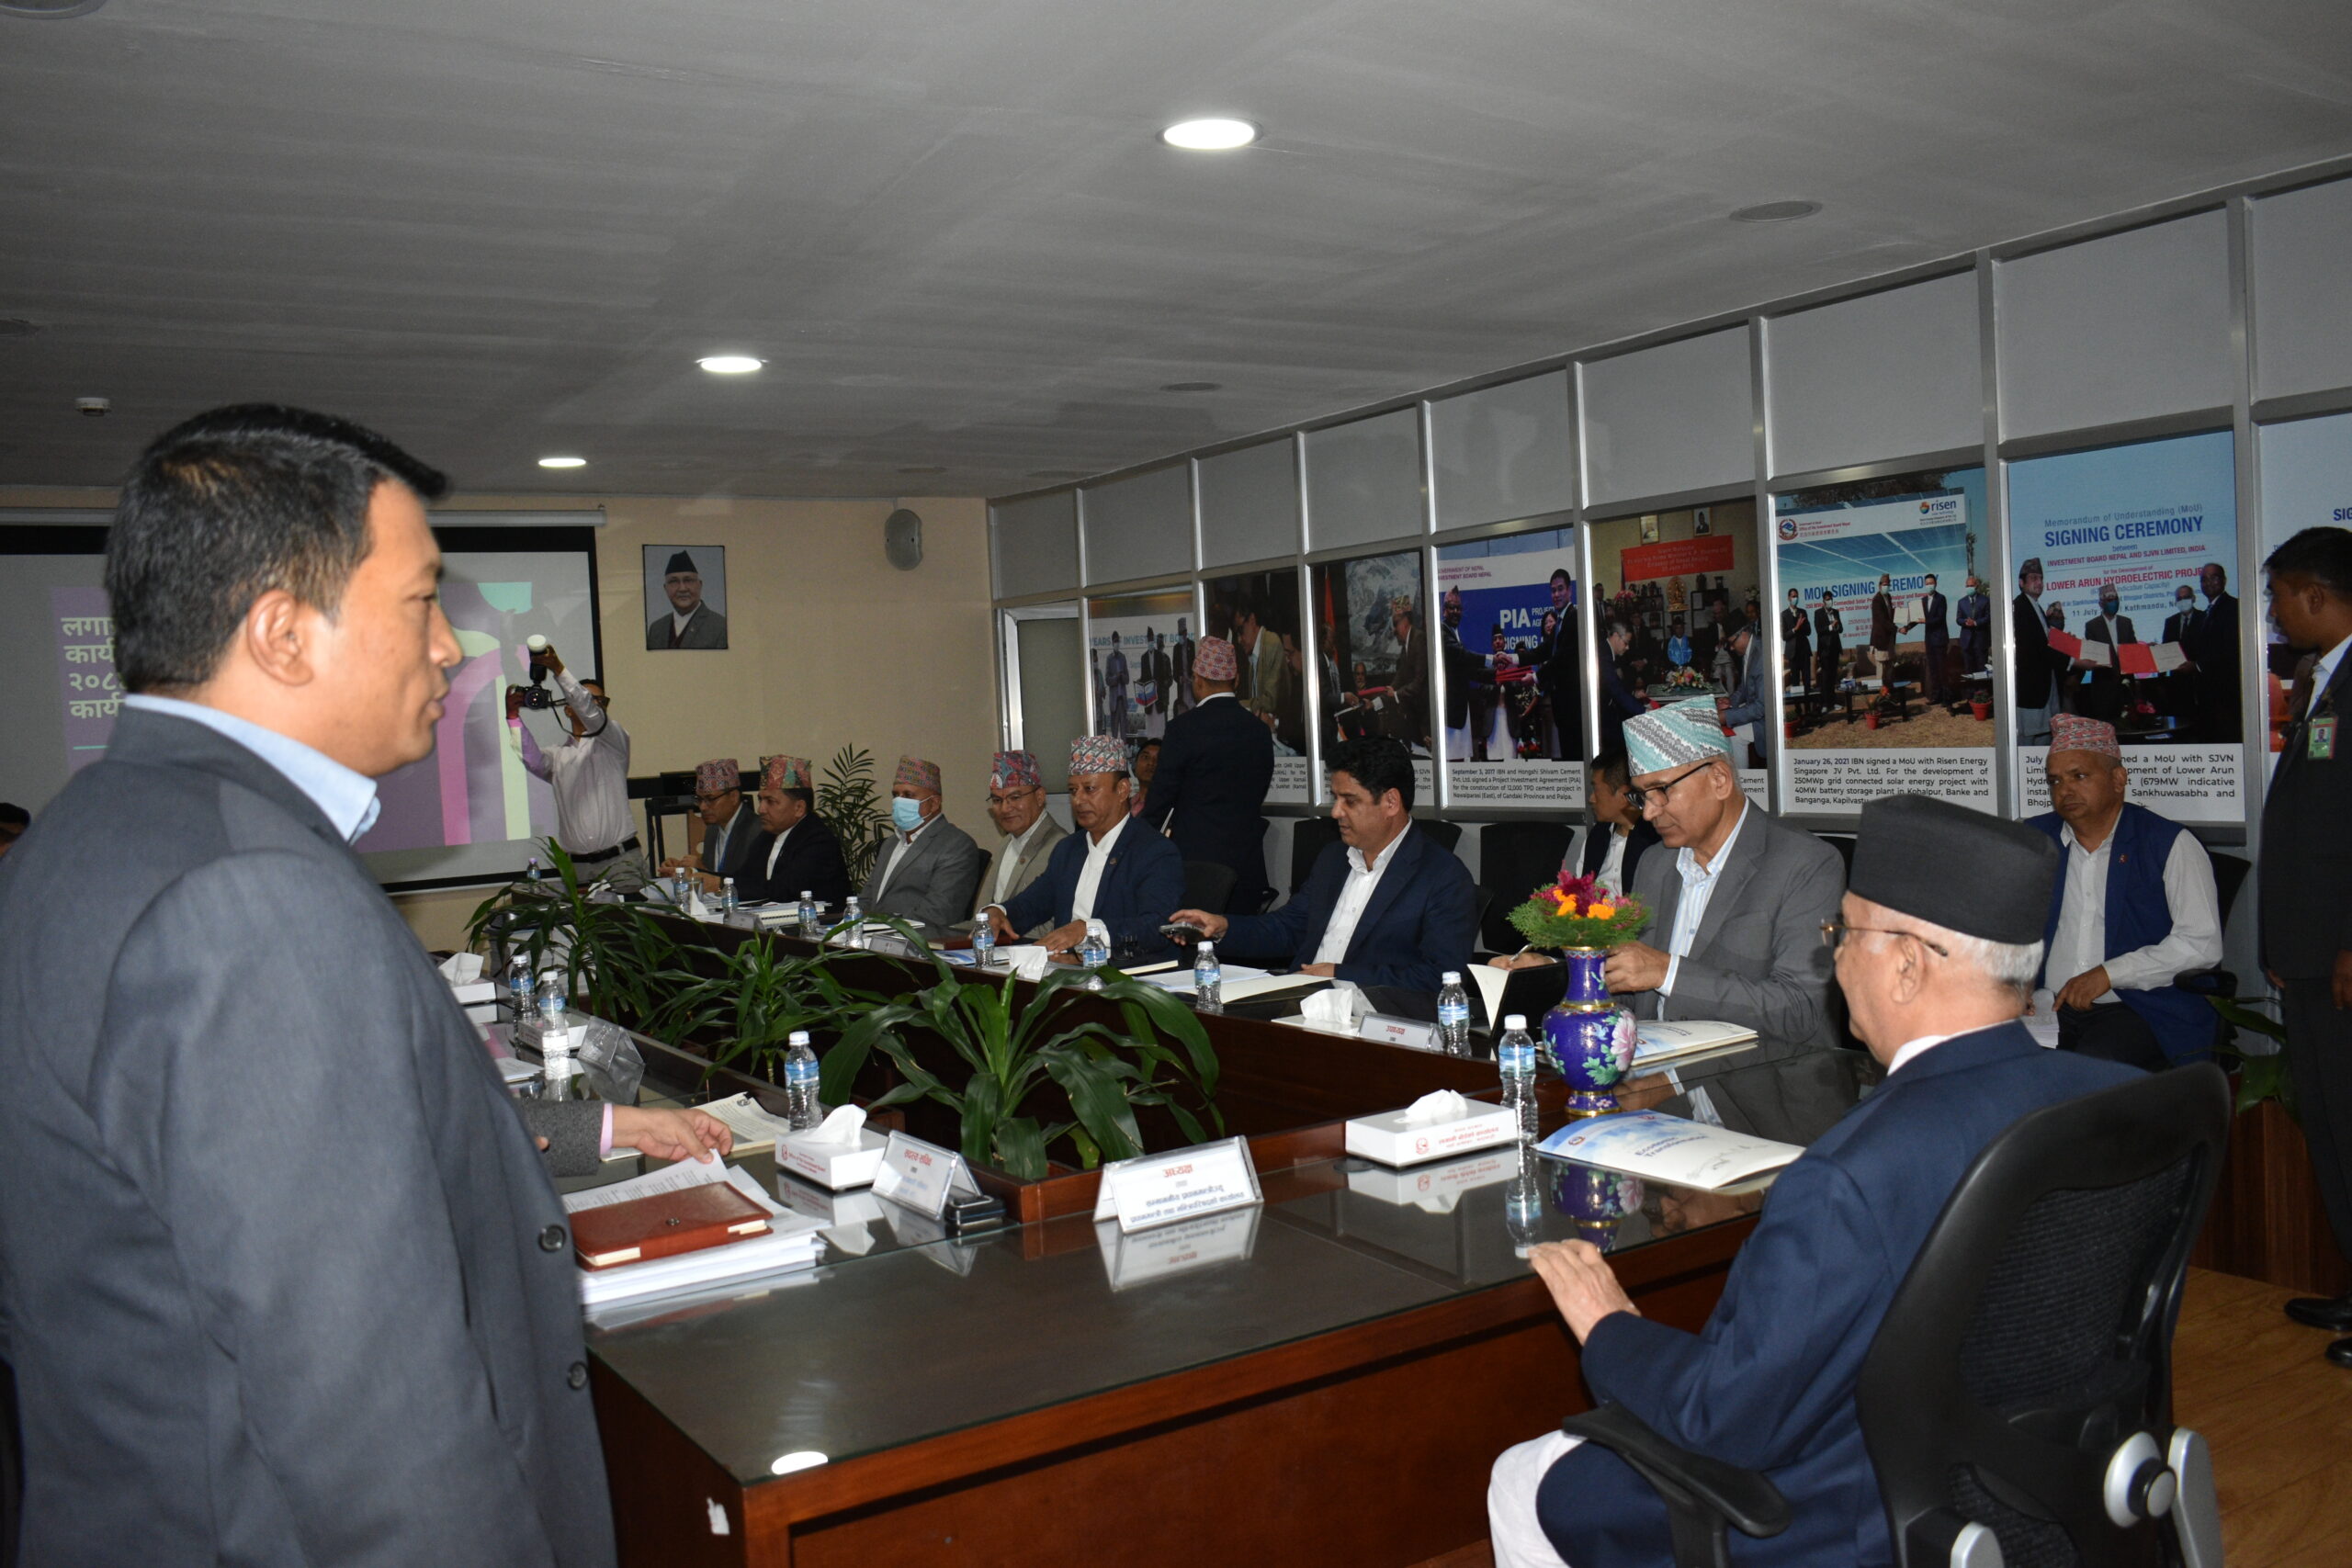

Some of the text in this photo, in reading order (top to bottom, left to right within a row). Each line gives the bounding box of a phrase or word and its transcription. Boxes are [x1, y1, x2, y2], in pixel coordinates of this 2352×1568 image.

[1931, 500, 1957, 511] risen
[2044, 503, 2203, 527] Memorandum of Understanding (MoU)
[2044, 515, 2203, 547] SIGNING CEREMONY
[2047, 557, 2085, 567] INVESTMENT
[2086, 554, 2108, 564] BOARD
[2109, 553, 2127, 561] NEPAL
[2130, 550, 2142, 558] AND
[2143, 548, 2159, 558] SJVN
[2188, 544, 2205, 553] INDIA
[2046, 566, 2202, 591] LOWER ARUN HYDROELECTRIC PROJE
[1832, 581, 1875, 599] SIGNING
[2124, 602, 2167, 613] Kathmandu,
[1499, 608, 1532, 629] PIA
[69, 691, 126, 719] कार्य
[1793, 758, 1820, 766] January
[1866, 758, 1889, 766] signed
[1961, 757, 1987, 766] Energy
[2025, 756, 2042, 765] July
[2121, 754, 2137, 762] ned
[2181, 754, 2202, 762] with
[2209, 754, 2233, 762] SJVN
[1794, 768, 1828, 776] Singapore
[1923, 768, 1974, 776] development
[2026, 766, 2047, 774] Limit
[2163, 766, 2172, 774] of
[2177, 766, 2205, 774] Lower
[2211, 766, 2234, 774] Arun
[1827, 777, 1842, 786] grid
[1939, 778, 1966, 786] project
[2140, 777, 2178, 786] (679MW
[2188, 777, 2235, 785] indicative
[1820, 786, 1844, 795] battery
[1847, 787, 1873, 795] storage
[1876, 787, 1894, 795] plant
[1907, 788, 1942, 796] Kohalpur,
[1974, 788, 1989, 796] and
[2028, 787, 2234, 797] instal Sankhuwasabha and
[1795, 796, 1831, 805] Banganga,
[2028, 798, 2052, 807] Bhojp
[1164, 1164, 1193, 1178] अध्यक्ष
